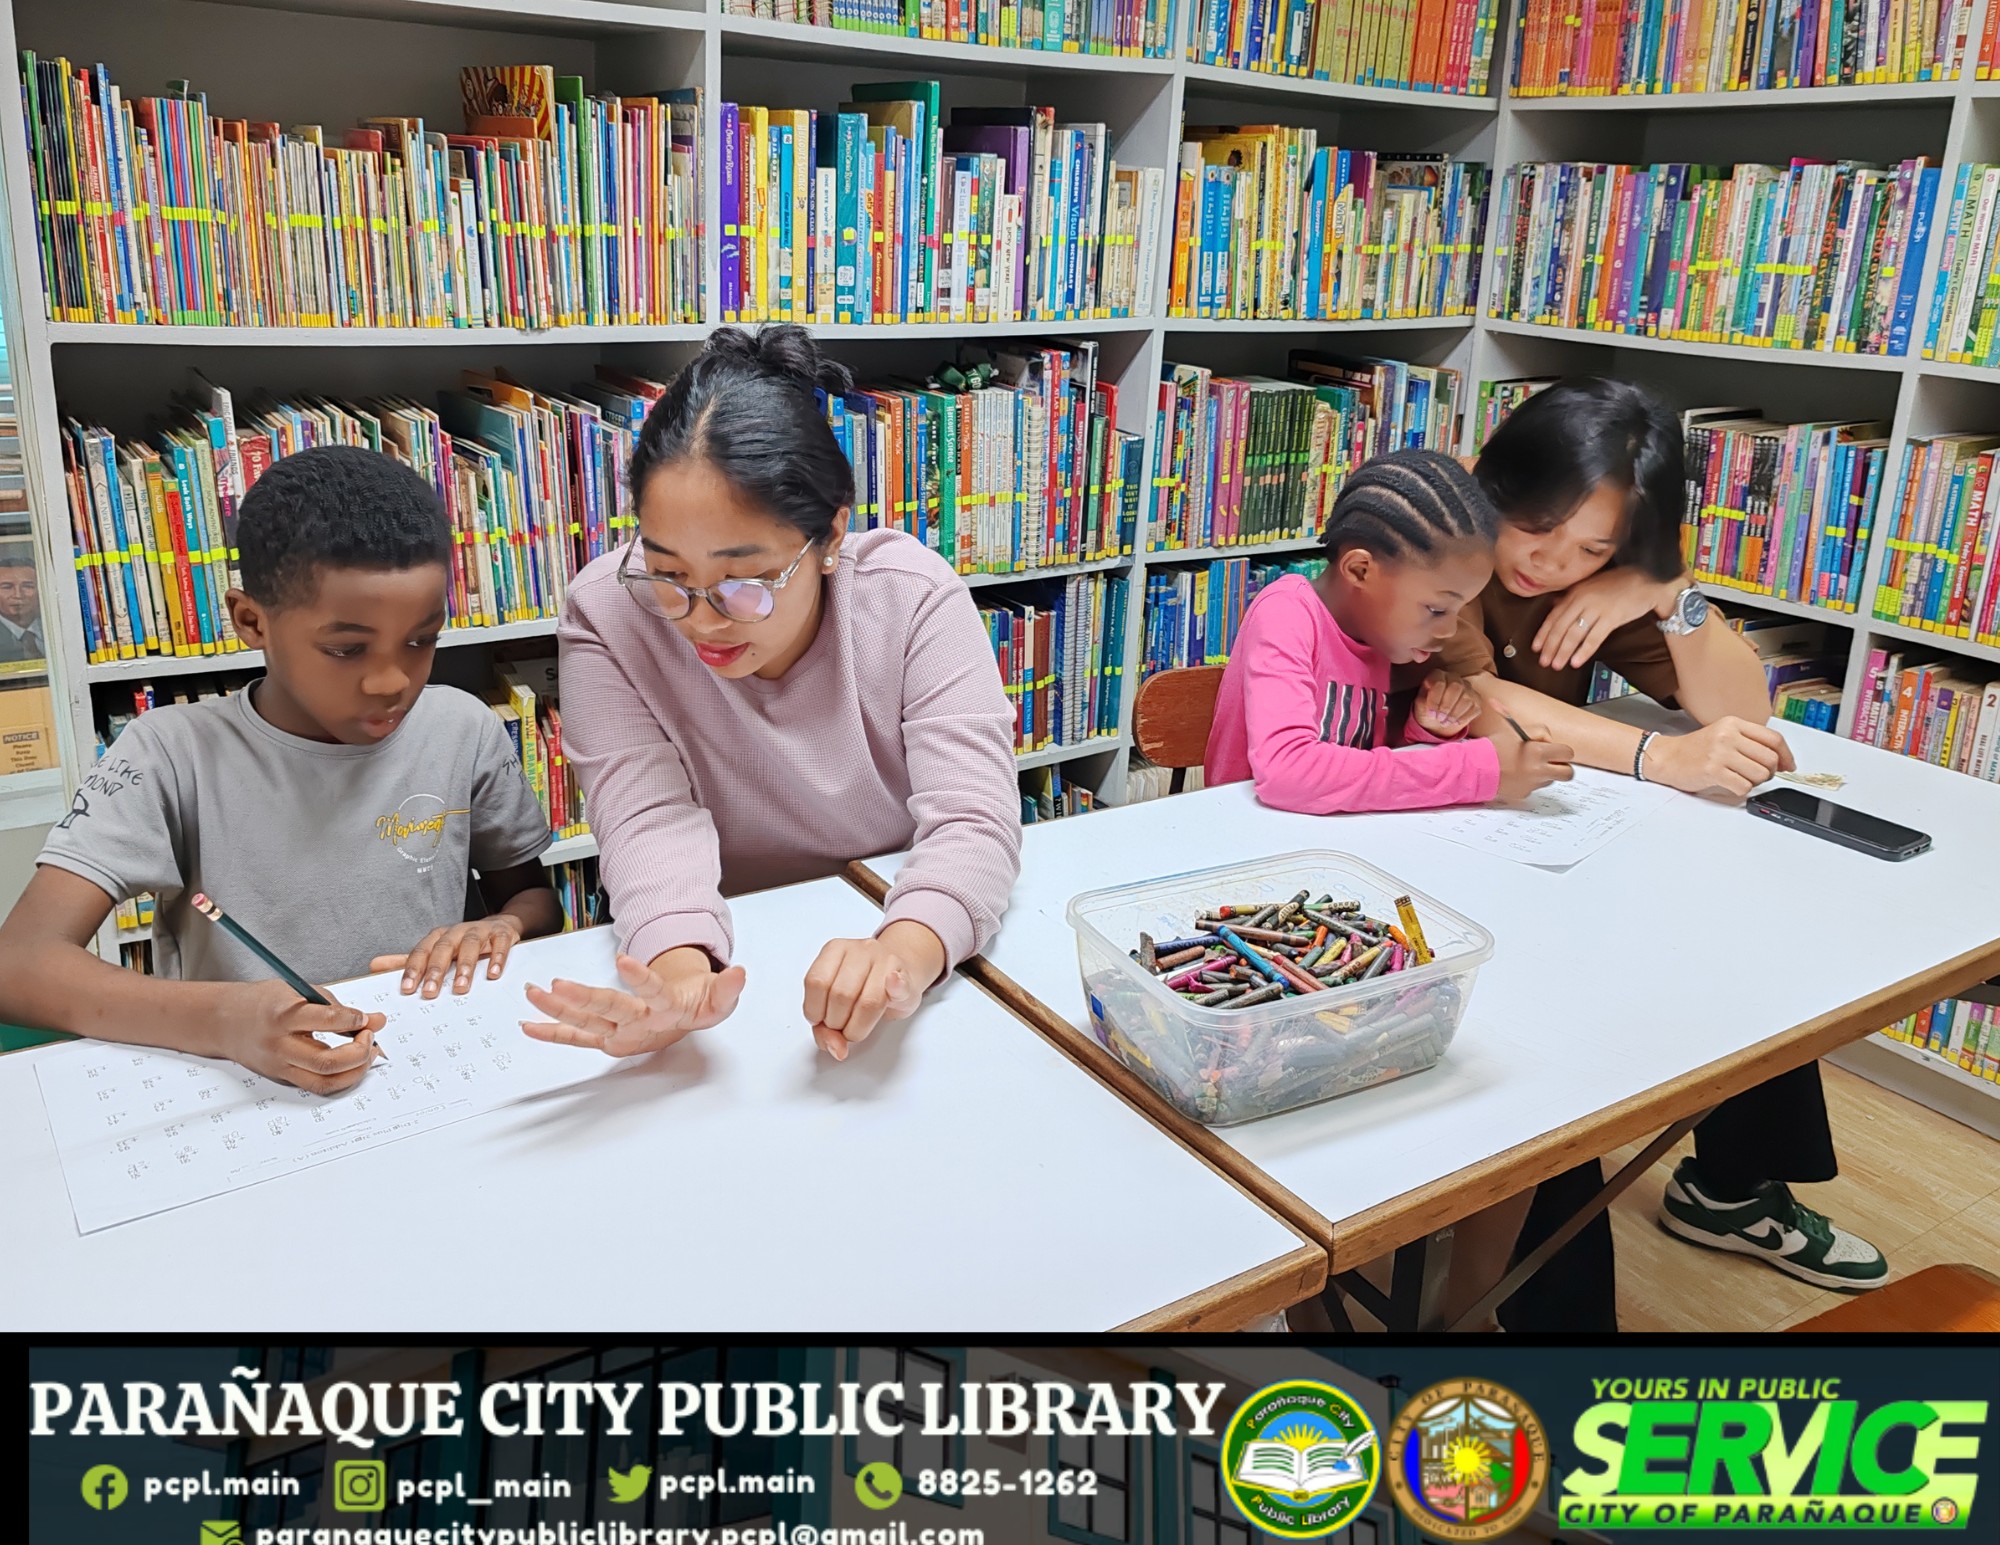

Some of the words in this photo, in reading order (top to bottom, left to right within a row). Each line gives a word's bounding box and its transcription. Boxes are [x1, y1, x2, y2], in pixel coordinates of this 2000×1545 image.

[1986, 0, 1997, 35] LENNIUM
[1070, 205, 1079, 240] Visual
[1335, 202, 1346, 239] Math
[1620, 191, 1632, 223] SCIENCE
[1960, 199, 1976, 238] MATH
[1977, 213, 1987, 232] World
[1067, 243, 1076, 289] DICTIONARY
[1969, 242, 1981, 266] MATH
[947, 438, 955, 463] Science
[1966, 490, 1984, 526] MATH
[1868, 702, 1880, 726] MATH
[4, 731, 40, 744] NOTICE
[108, 757, 145, 786] LIKE
